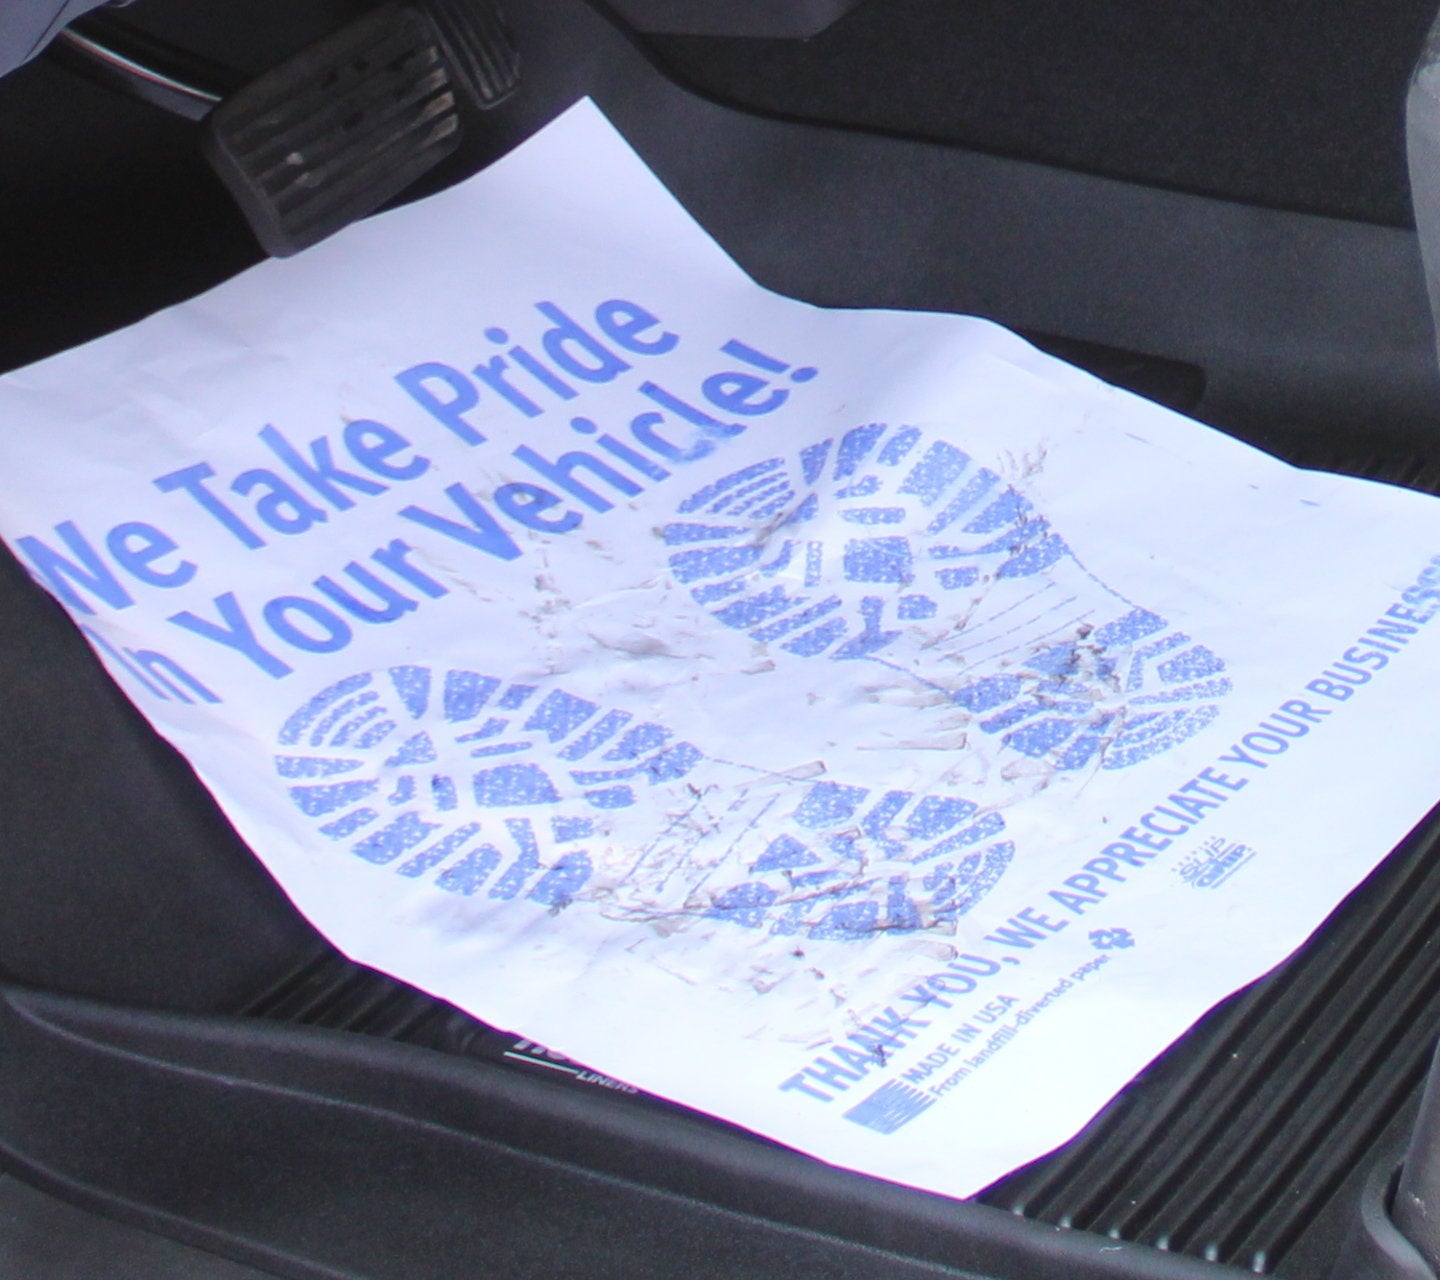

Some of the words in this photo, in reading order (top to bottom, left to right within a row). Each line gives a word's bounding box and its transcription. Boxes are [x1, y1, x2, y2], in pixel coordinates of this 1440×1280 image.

[16, 520, 198, 615] We
[153, 417, 430, 549] Take
[395, 298, 680, 446] Pride
[167, 537, 449, 680] Your
[401, 339, 819, 561] Vehicle!
[777, 1006, 931, 1102] THANK
[900, 953, 1021, 1008] YOU,
[983, 906, 1070, 948] WE
[1048, 766, 1250, 915] APPRECIATE
[1218, 698, 1332, 769] YOUR
[902, 1042, 961, 1084] MADE
[951, 1022, 982, 1044] IN
[972, 994, 1020, 1024] USA
[930, 1066, 972, 1096] From
